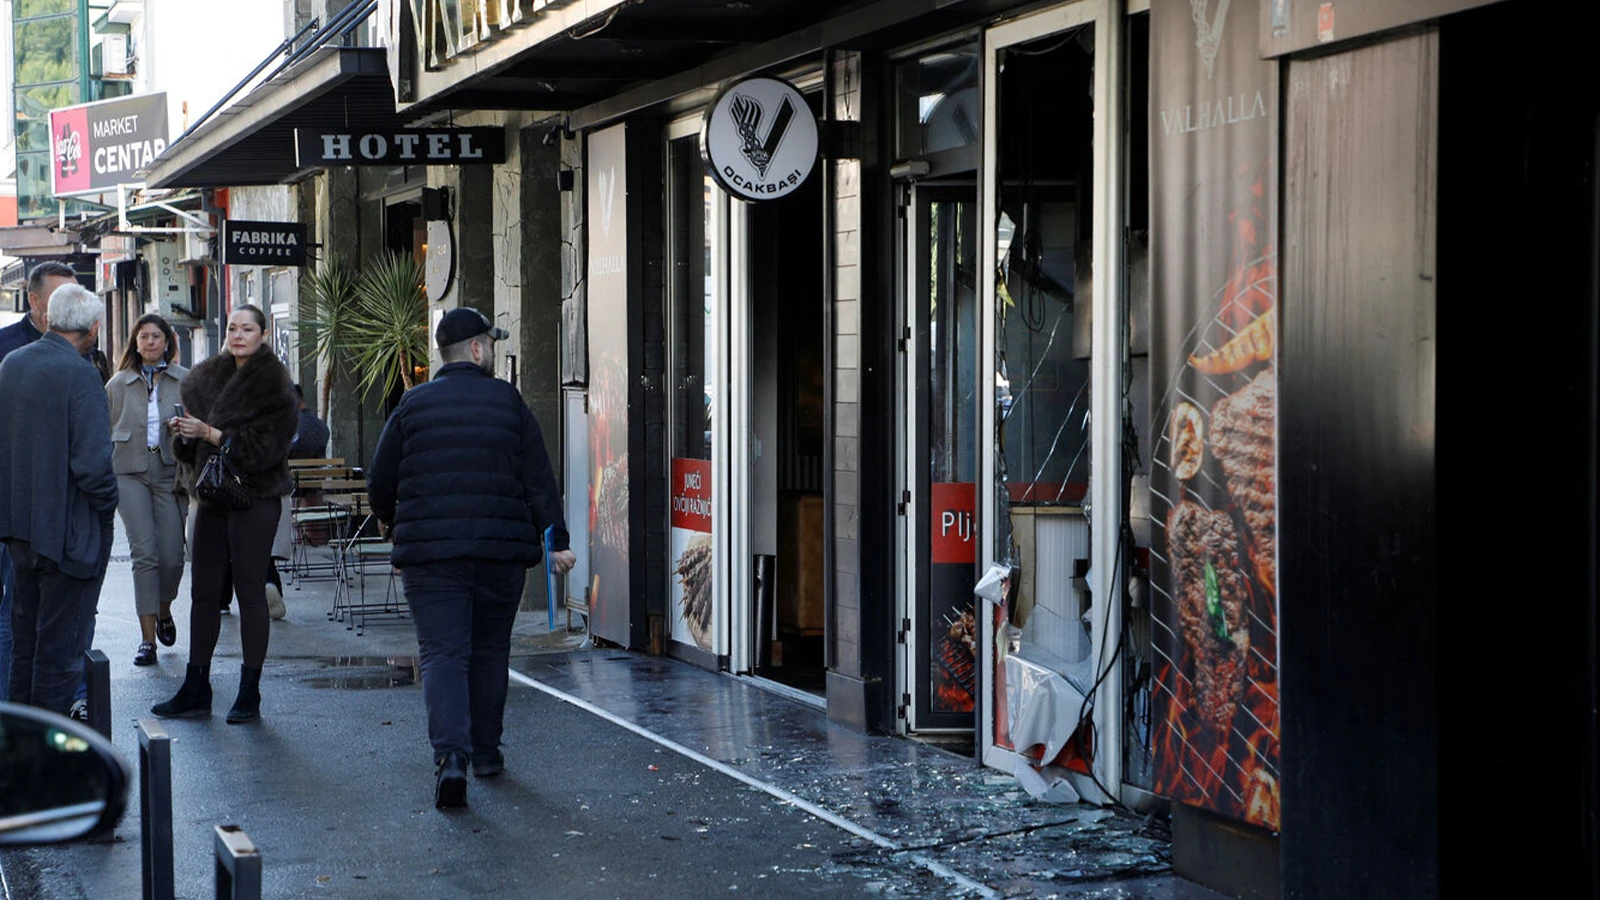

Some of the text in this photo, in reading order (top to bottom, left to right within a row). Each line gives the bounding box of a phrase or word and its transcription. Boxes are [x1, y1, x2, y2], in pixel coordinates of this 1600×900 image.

[1161, 91, 1266, 136] VALHALLA
[93, 115, 138, 138] MARKET
[321, 133, 483, 160] HOTEL
[723, 165, 802, 194] OCAKBAŞI
[232, 230, 297, 246] FABRIKA
[239, 247, 291, 256] COFFEE
